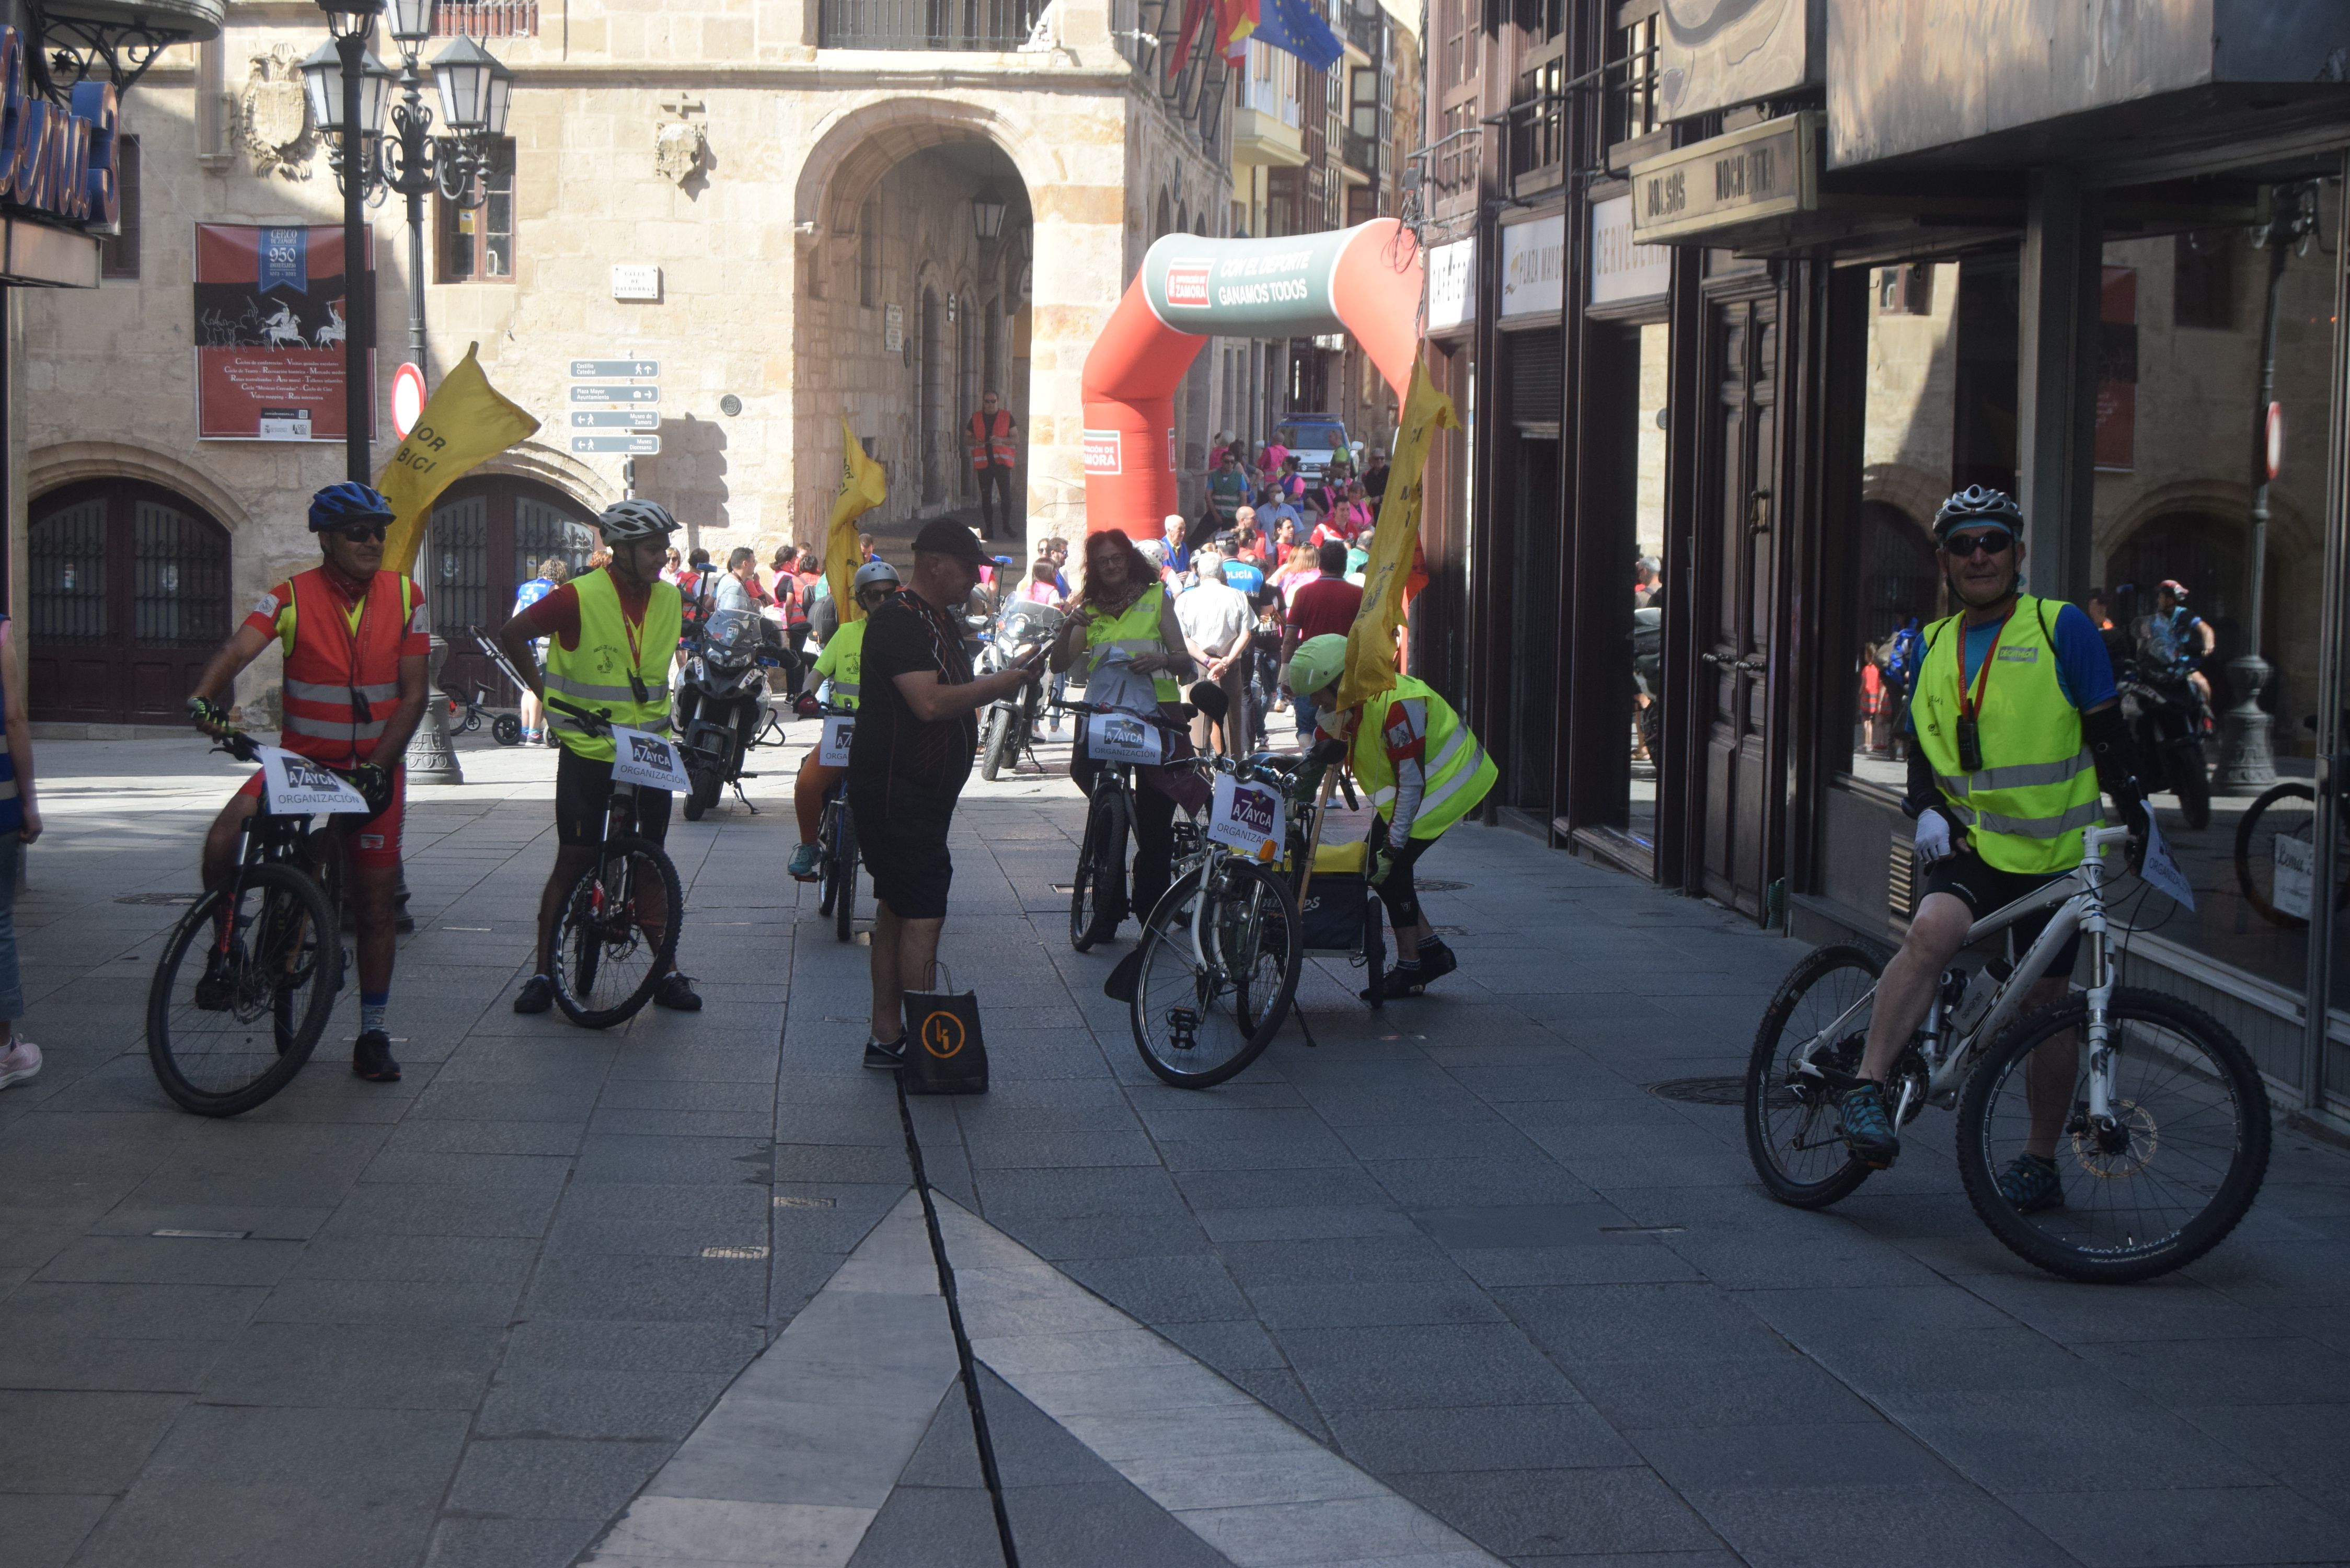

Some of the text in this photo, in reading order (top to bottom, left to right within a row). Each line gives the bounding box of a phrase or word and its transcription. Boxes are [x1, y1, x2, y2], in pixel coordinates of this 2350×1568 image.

[1648, 171, 1685, 217] BOLSOS
[271, 229, 297, 238] CERCO
[270, 247, 295, 262] 950
[1220, 250, 1314, 278] CON EL DEPORTE
[1519, 249, 1538, 285] PLAZA
[1176, 284, 1206, 298] ZAMORA
[1218, 278, 1308, 306] GANAMOS TODOS
[397, 447, 437, 474] BICI
[1095, 747, 1156, 758] ORGANIZACIÓN
[620, 765, 686, 785] ORGANIZACIÓN
[278, 793, 360, 804] ORGANIZACIÓN
[1217, 823, 1281, 850] ORGANIZACN
